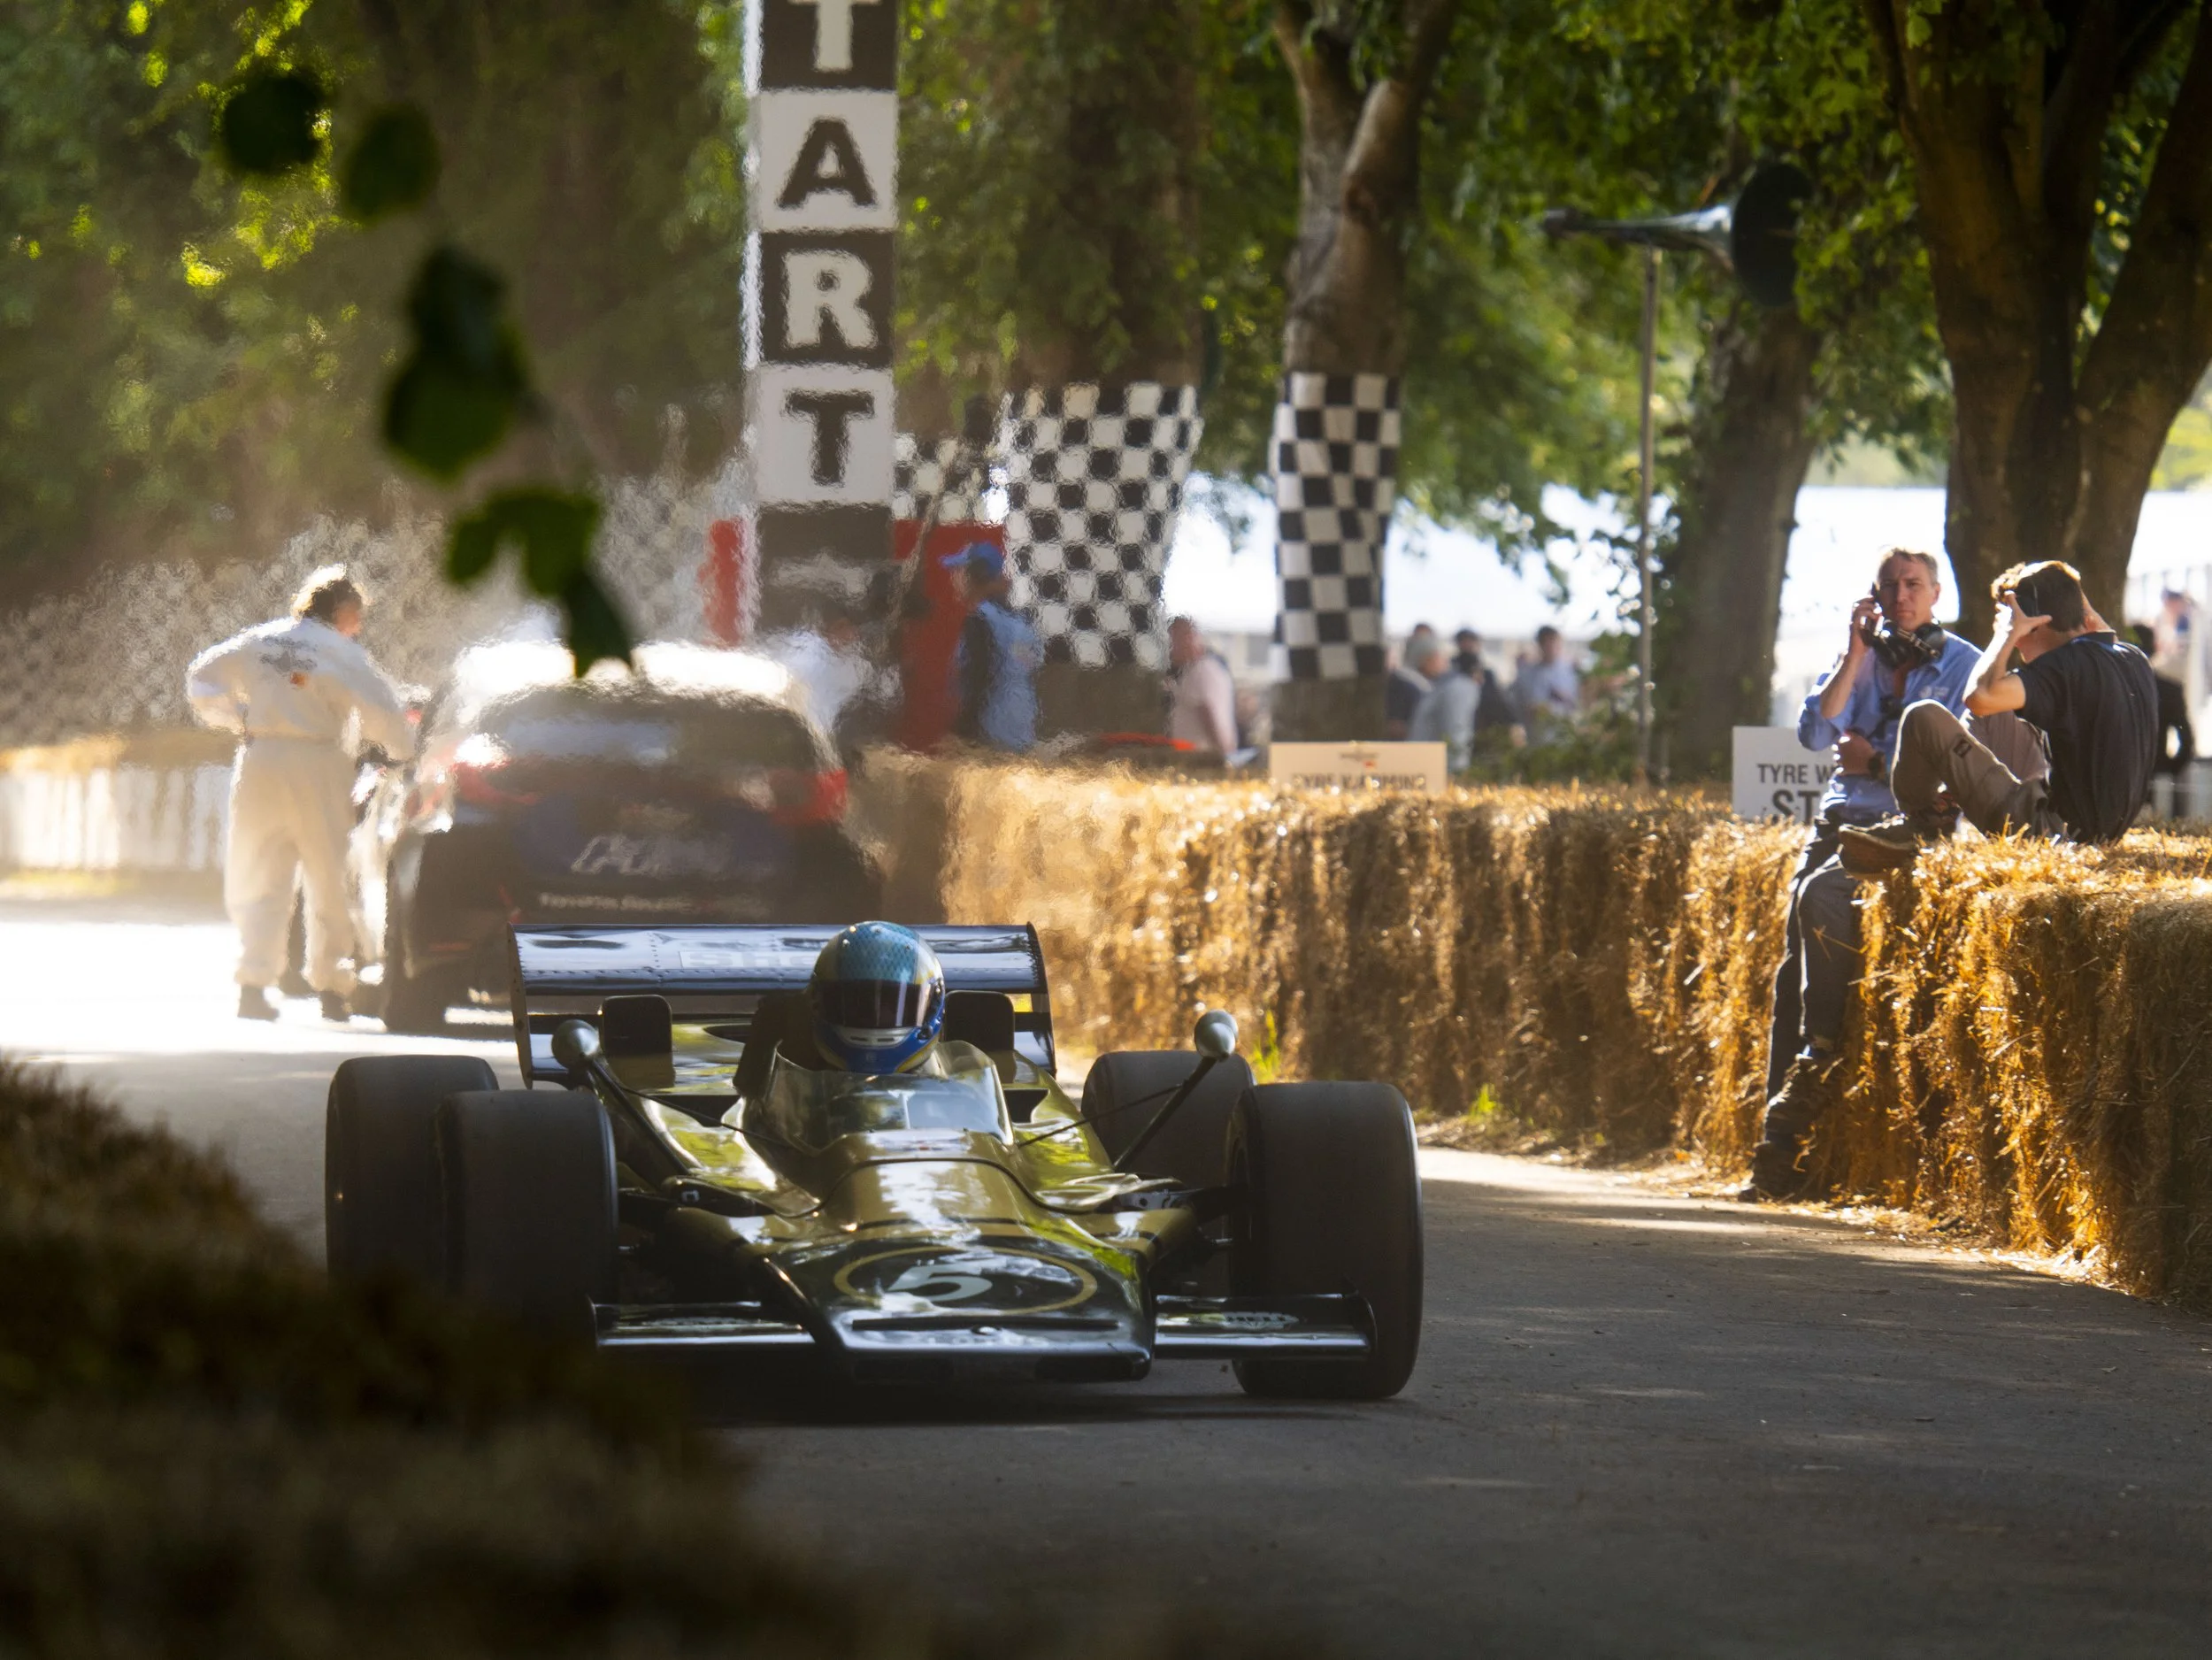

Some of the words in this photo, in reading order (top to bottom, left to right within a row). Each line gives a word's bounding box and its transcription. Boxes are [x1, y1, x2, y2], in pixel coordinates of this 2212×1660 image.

[1756, 764, 1809, 784] TYRE
[1815, 765, 1838, 784] W
[1772, 789, 1820, 826] ST
[689, 951, 816, 968] She
[887, 1263, 993, 1303] 5
